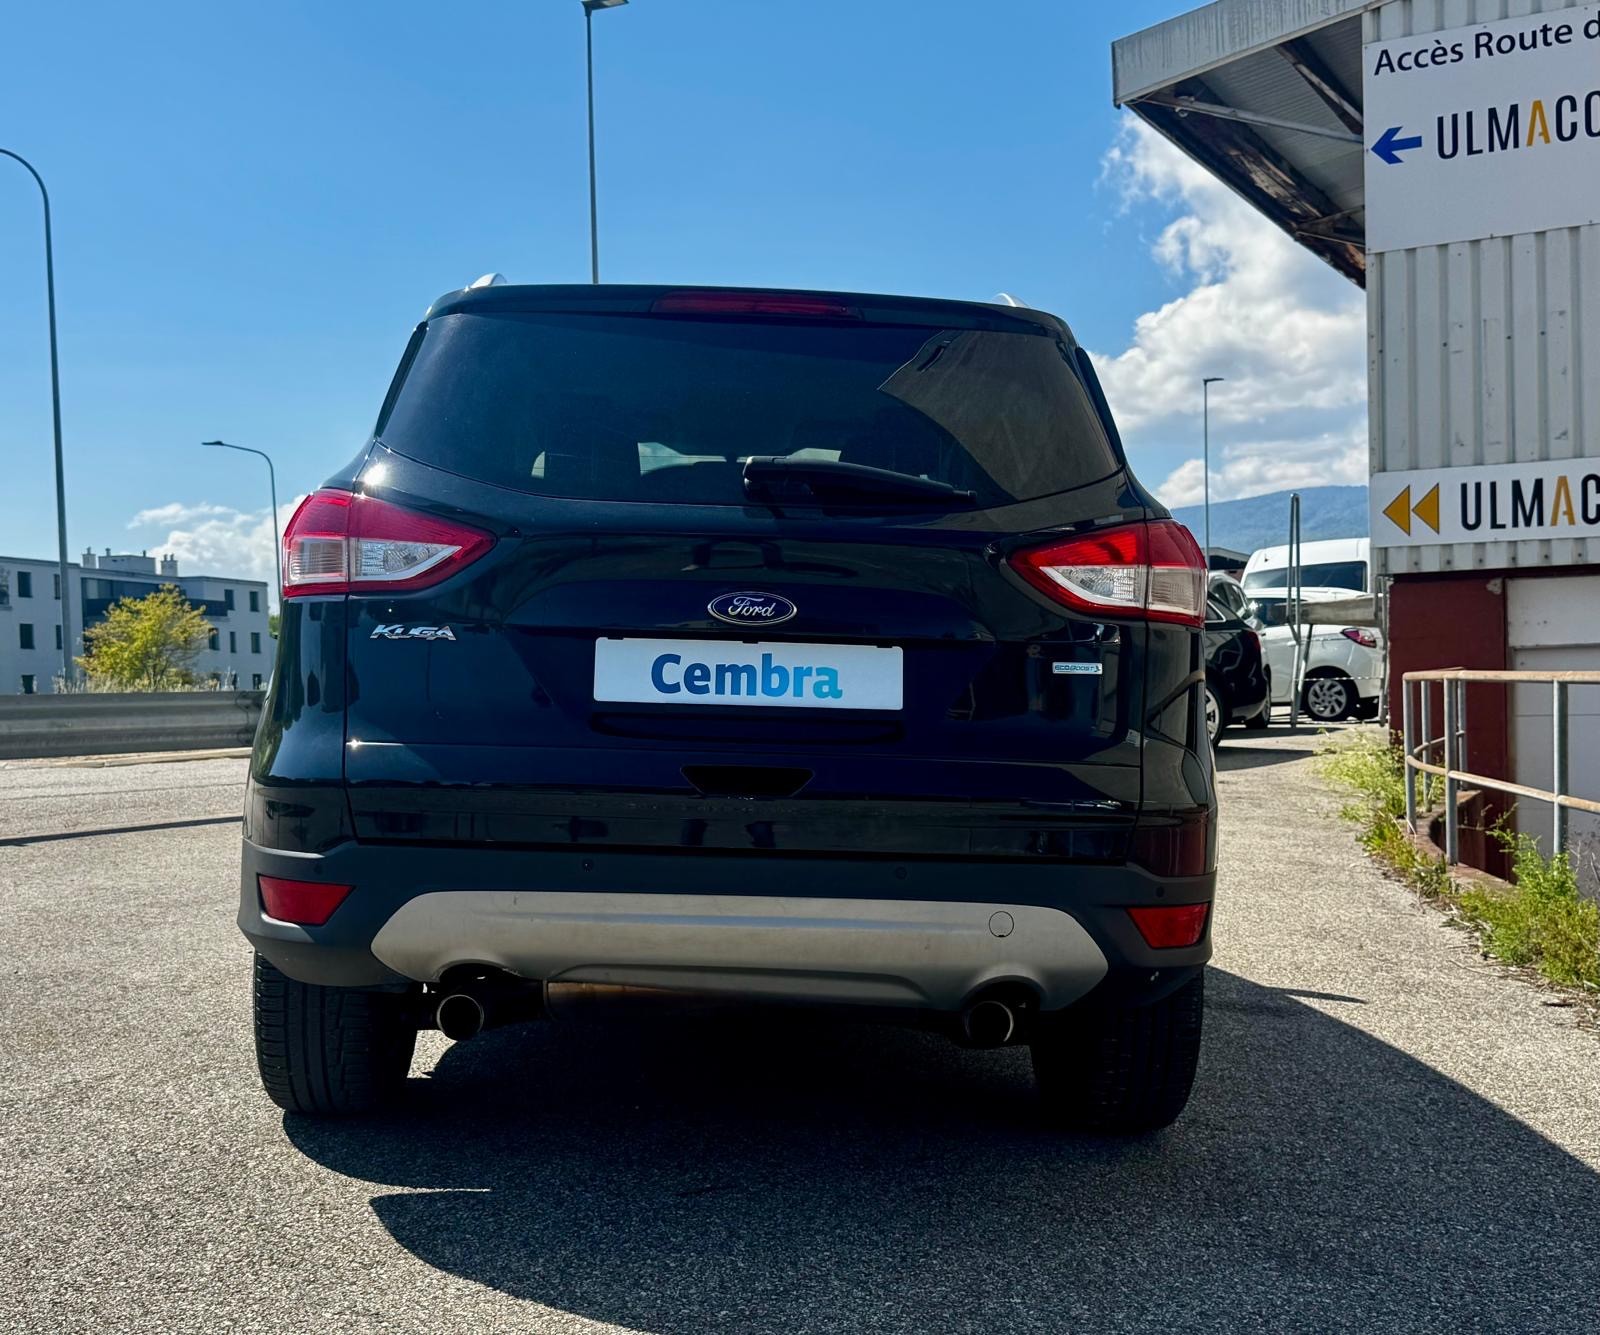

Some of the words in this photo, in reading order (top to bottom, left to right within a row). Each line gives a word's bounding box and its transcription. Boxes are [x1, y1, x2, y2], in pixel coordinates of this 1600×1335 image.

[1374, 40, 1463, 76] Accès
[1474, 23, 1573, 59] Route
[1460, 473, 1600, 531] ULMAC
[728, 596, 776, 616] Ford
[369, 624, 456, 640] KUGA
[650, 653, 843, 699] Cembra
